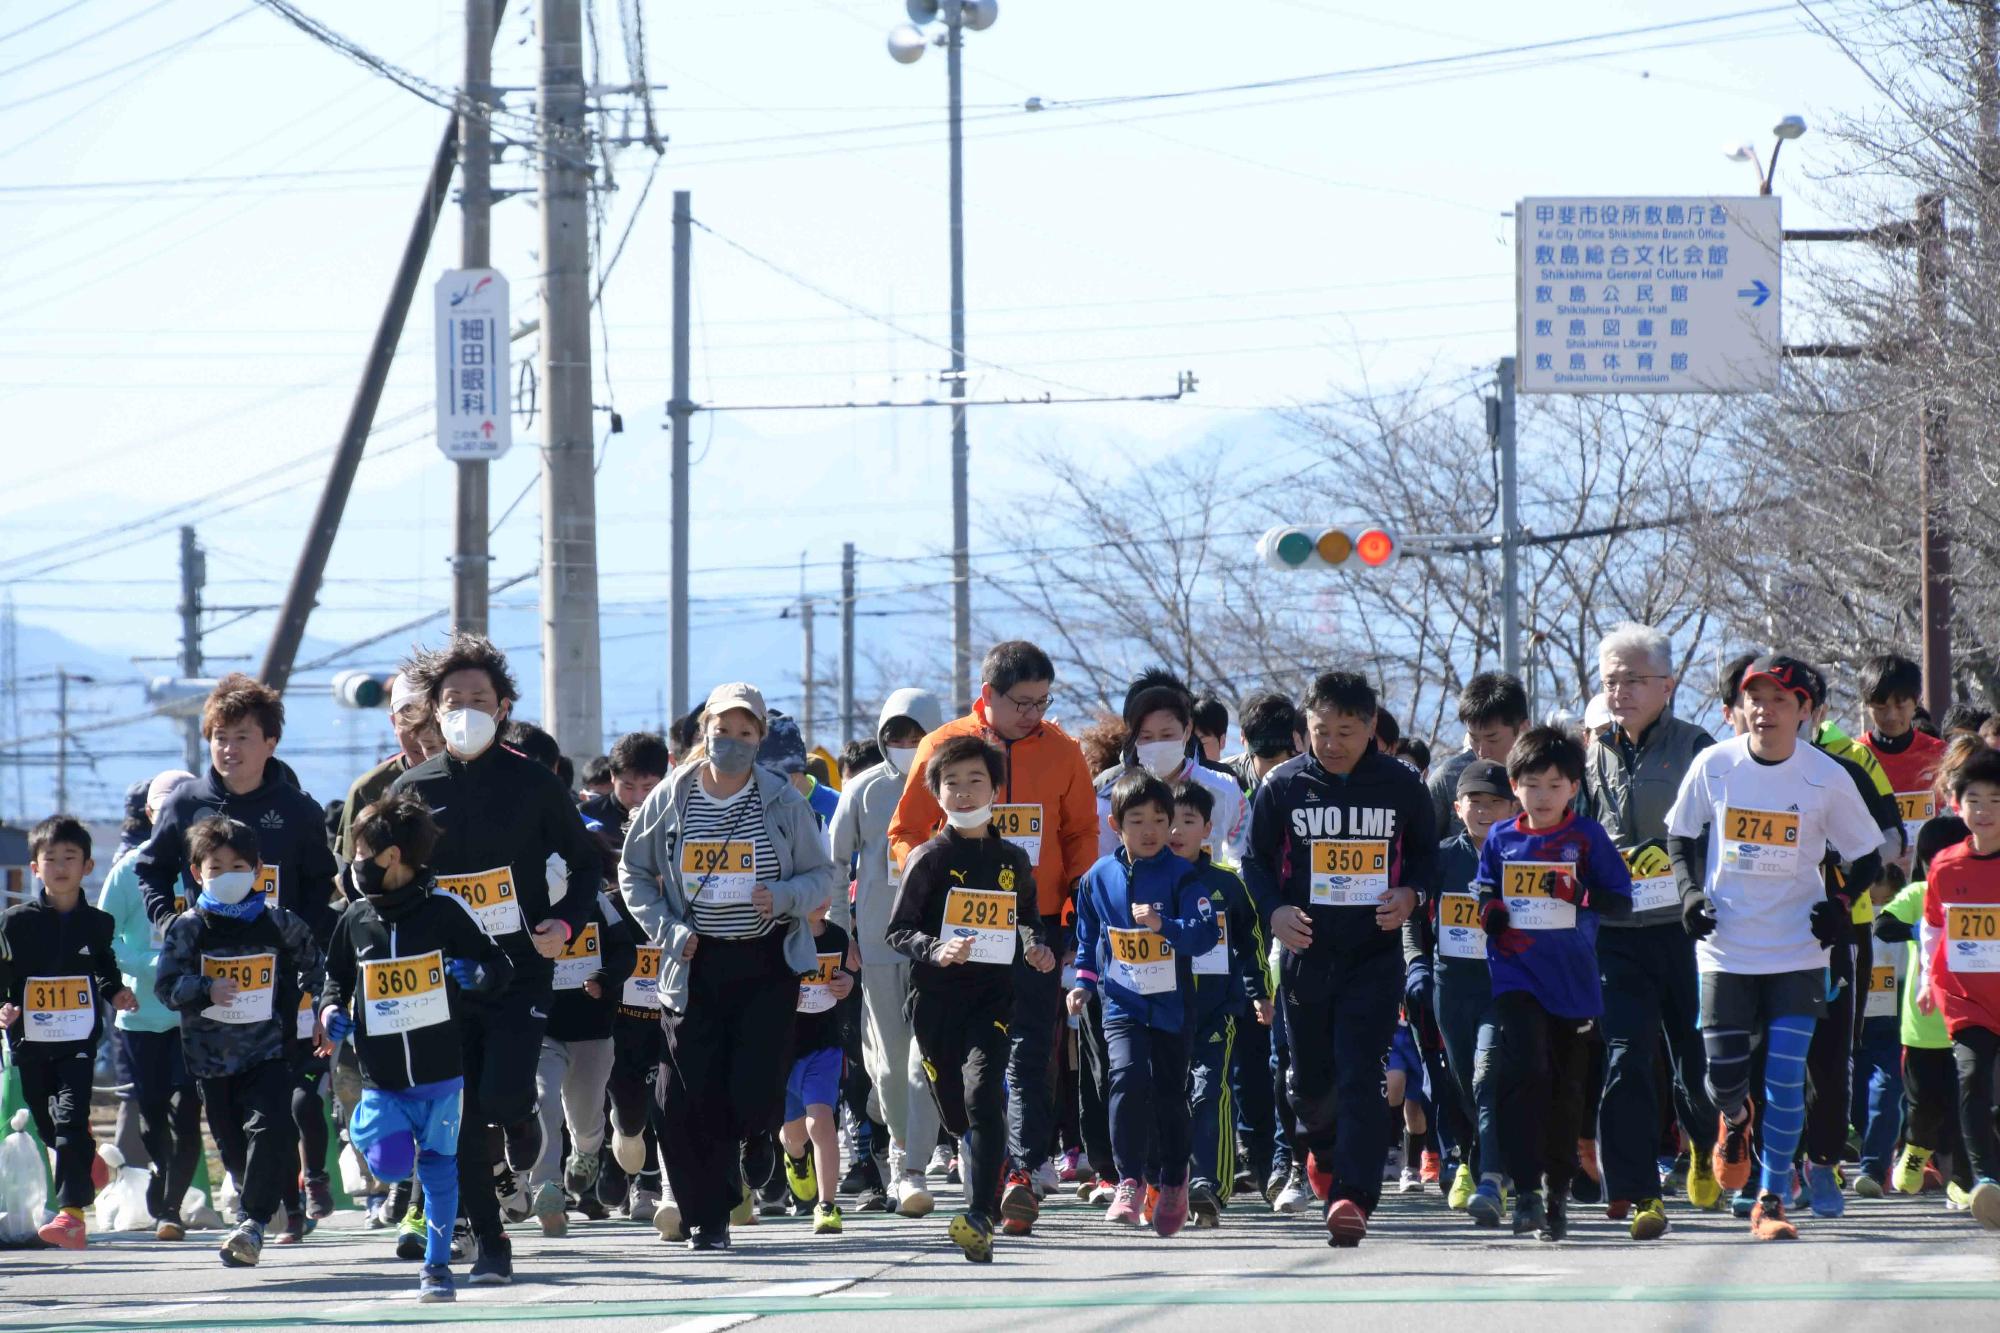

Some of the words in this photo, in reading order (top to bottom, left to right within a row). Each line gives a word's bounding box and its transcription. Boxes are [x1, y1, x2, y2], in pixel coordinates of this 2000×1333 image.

[1536, 205, 1727, 225] 甲斐市役所敷島庁舎
[1538, 230, 1553, 239] Kai
[1557, 229, 1573, 240] City
[1578, 228, 1604, 240] Office
[1609, 228, 1659, 240] Shikishima
[1662, 228, 1694, 240] Branch
[1698, 228, 1726, 240] Office
[1536, 245, 1728, 265] 敷島総合文化会館
[1541, 269, 1602, 280] Shikishima
[1607, 269, 1651, 280] General
[1657, 269, 1697, 280] Culture
[1701, 268, 1724, 280] Hall
[1536, 285, 1688, 303] 敷島公民館
[1557, 305, 1611, 315] Shikishima
[1614, 305, 1644, 315] Public
[1648, 304, 1668, 314] Hall
[1536, 319, 1688, 336] 敷島図書館
[1566, 339, 1619, 349] Shikishima
[1623, 339, 1657, 350] Library
[460, 319, 486, 416] 細田眼科
[1536, 353, 1688, 370] 敷島体育館
[1554, 373, 1607, 383] Shikishima
[1611, 373, 1669, 384] Gymnasium
[990, 813, 1019, 834] 49
[1031, 819, 1039, 831] D
[1737, 816, 1773, 841] 274
[1786, 828, 1796, 841] C
[694, 849, 729, 870] 292
[743, 856, 751, 867] C
[1327, 849, 1363, 871] 350
[1374, 857, 1383, 869] D
[1762, 848, 1796, 858] メイコー
[265, 881, 274, 892] D
[721, 877, 755, 885] メイコー
[499, 884, 510, 897] D
[961, 899, 998, 925] 292
[1008, 911, 1014, 924] C
[1961, 914, 1996, 937] 270
[586, 939, 596, 951] C
[1118, 938, 1150, 960] 350
[1162, 943, 1170, 955] D
[261, 970, 269, 983] D
[377, 967, 417, 995] 360
[430, 970, 440, 984] D
[36, 987, 66, 1009] 311
[78, 992, 87, 1004] D
